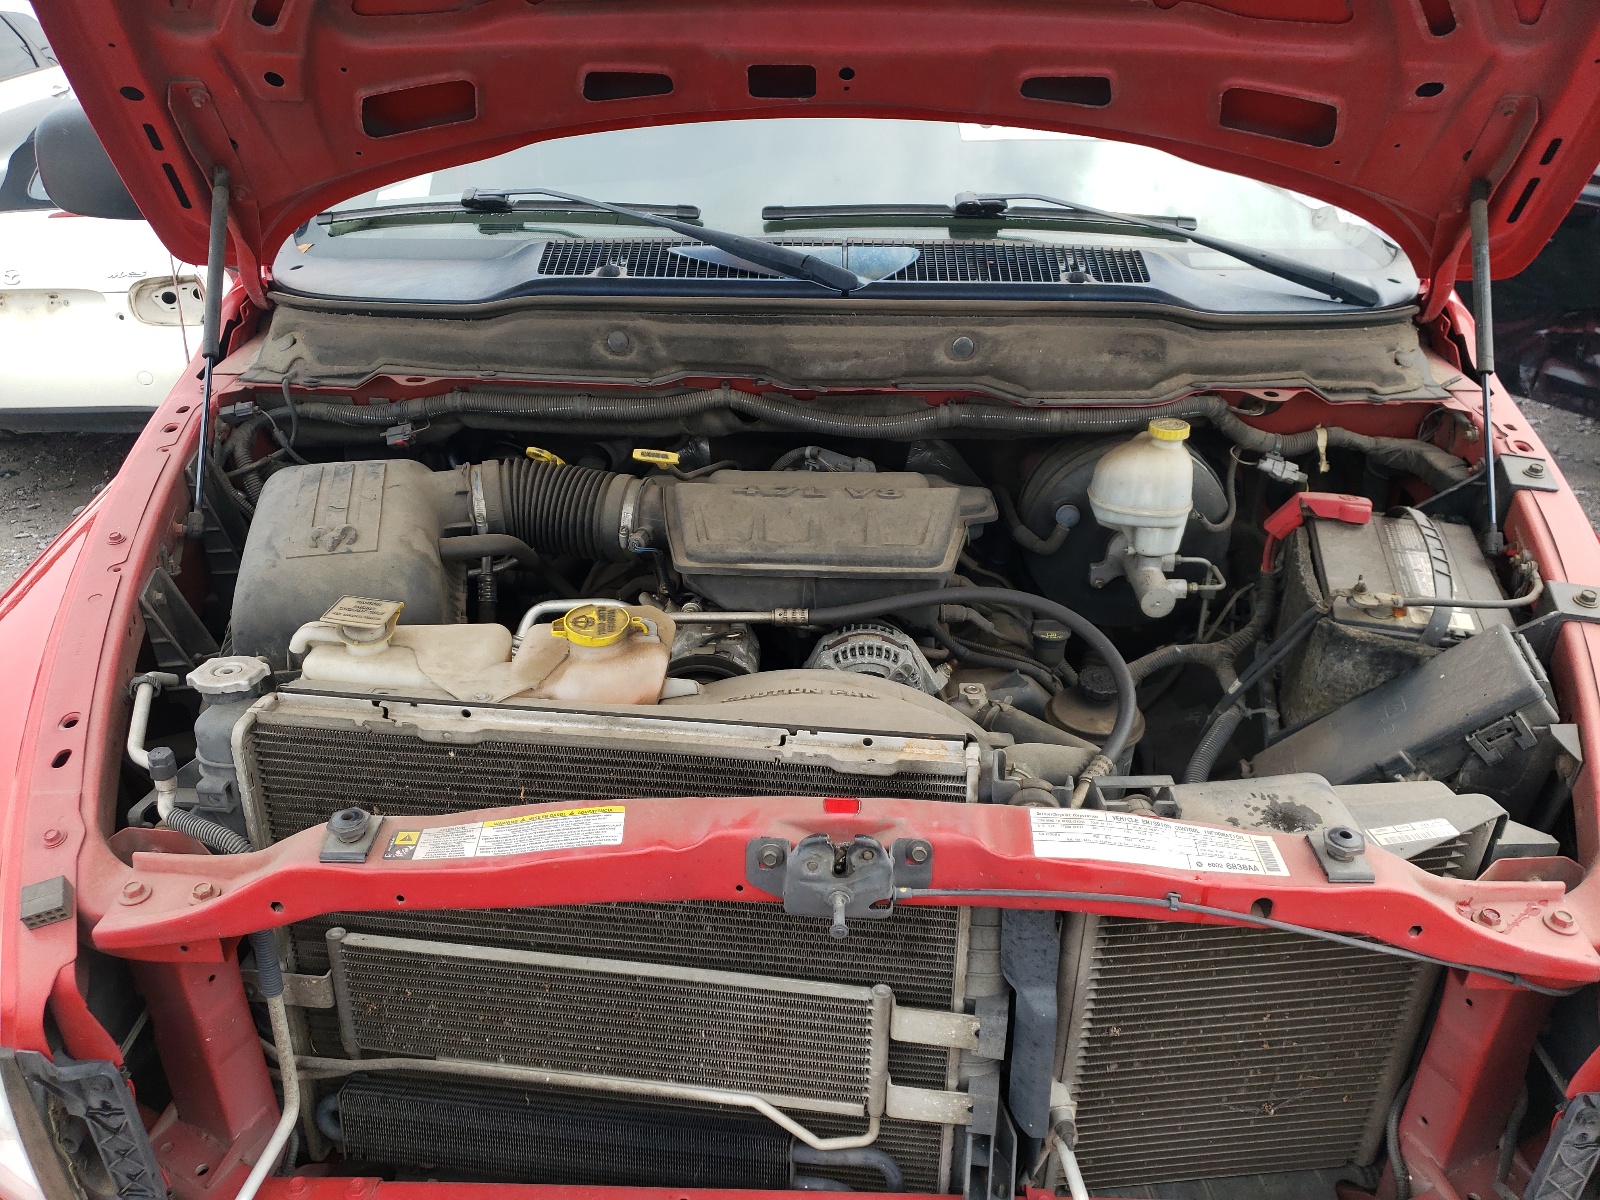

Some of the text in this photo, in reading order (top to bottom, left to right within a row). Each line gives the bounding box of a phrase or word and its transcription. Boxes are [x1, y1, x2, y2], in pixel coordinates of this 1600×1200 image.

[844, 486, 904, 499] V8
[1112, 815, 1139, 823] VEHICLE
[1142, 820, 1172, 829] EMISSION
[1174, 825, 1200, 834] CONTROL
[1204, 830, 1244, 840] INFORMATION
[1226, 863, 1260, 872] 6838AA
